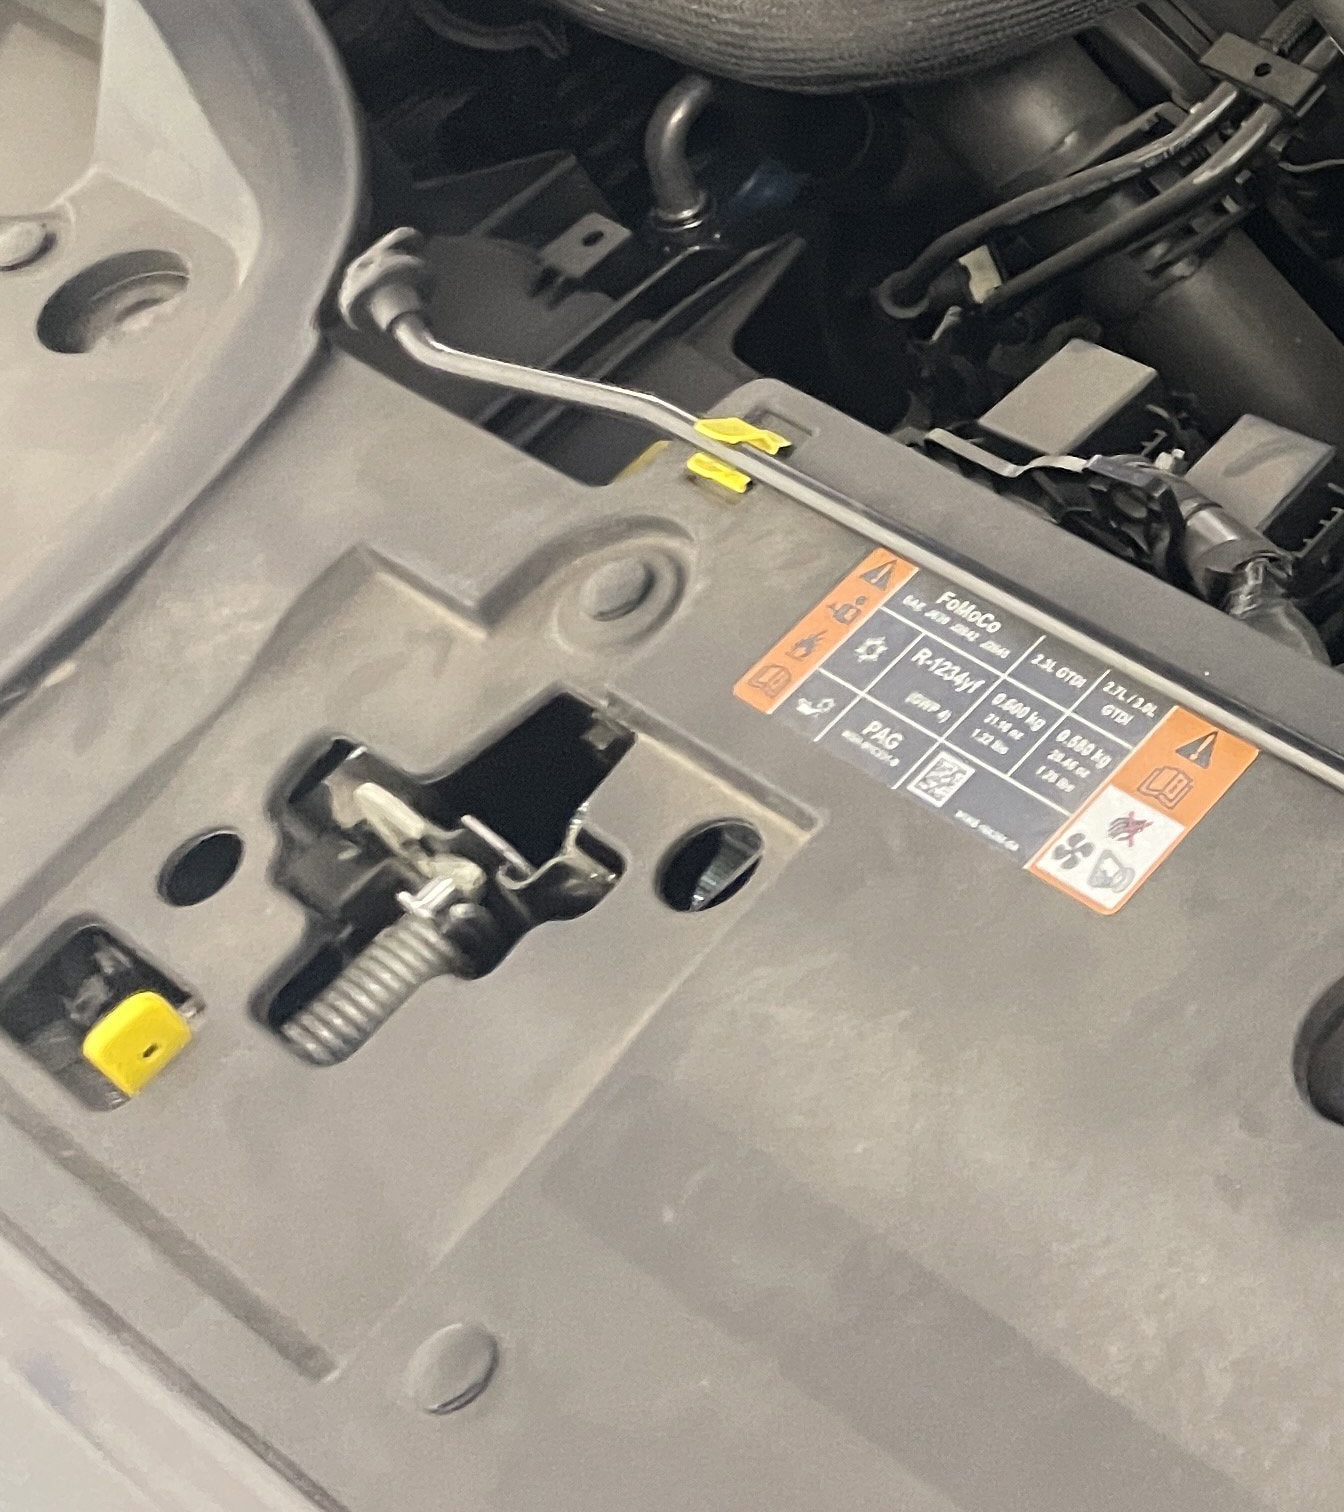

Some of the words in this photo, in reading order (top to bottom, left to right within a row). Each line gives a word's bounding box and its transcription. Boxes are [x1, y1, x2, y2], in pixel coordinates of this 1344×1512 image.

[936, 591, 1002, 634] FoMoCo
[911, 647, 986, 694] R-1234yf
[1055, 666, 1088, 689] GTDI
[1024, 711, 1047, 732] kg
[1101, 704, 1136, 727] GTDI
[862, 720, 905, 751] PAG
[1090, 748, 1112, 770] kg
